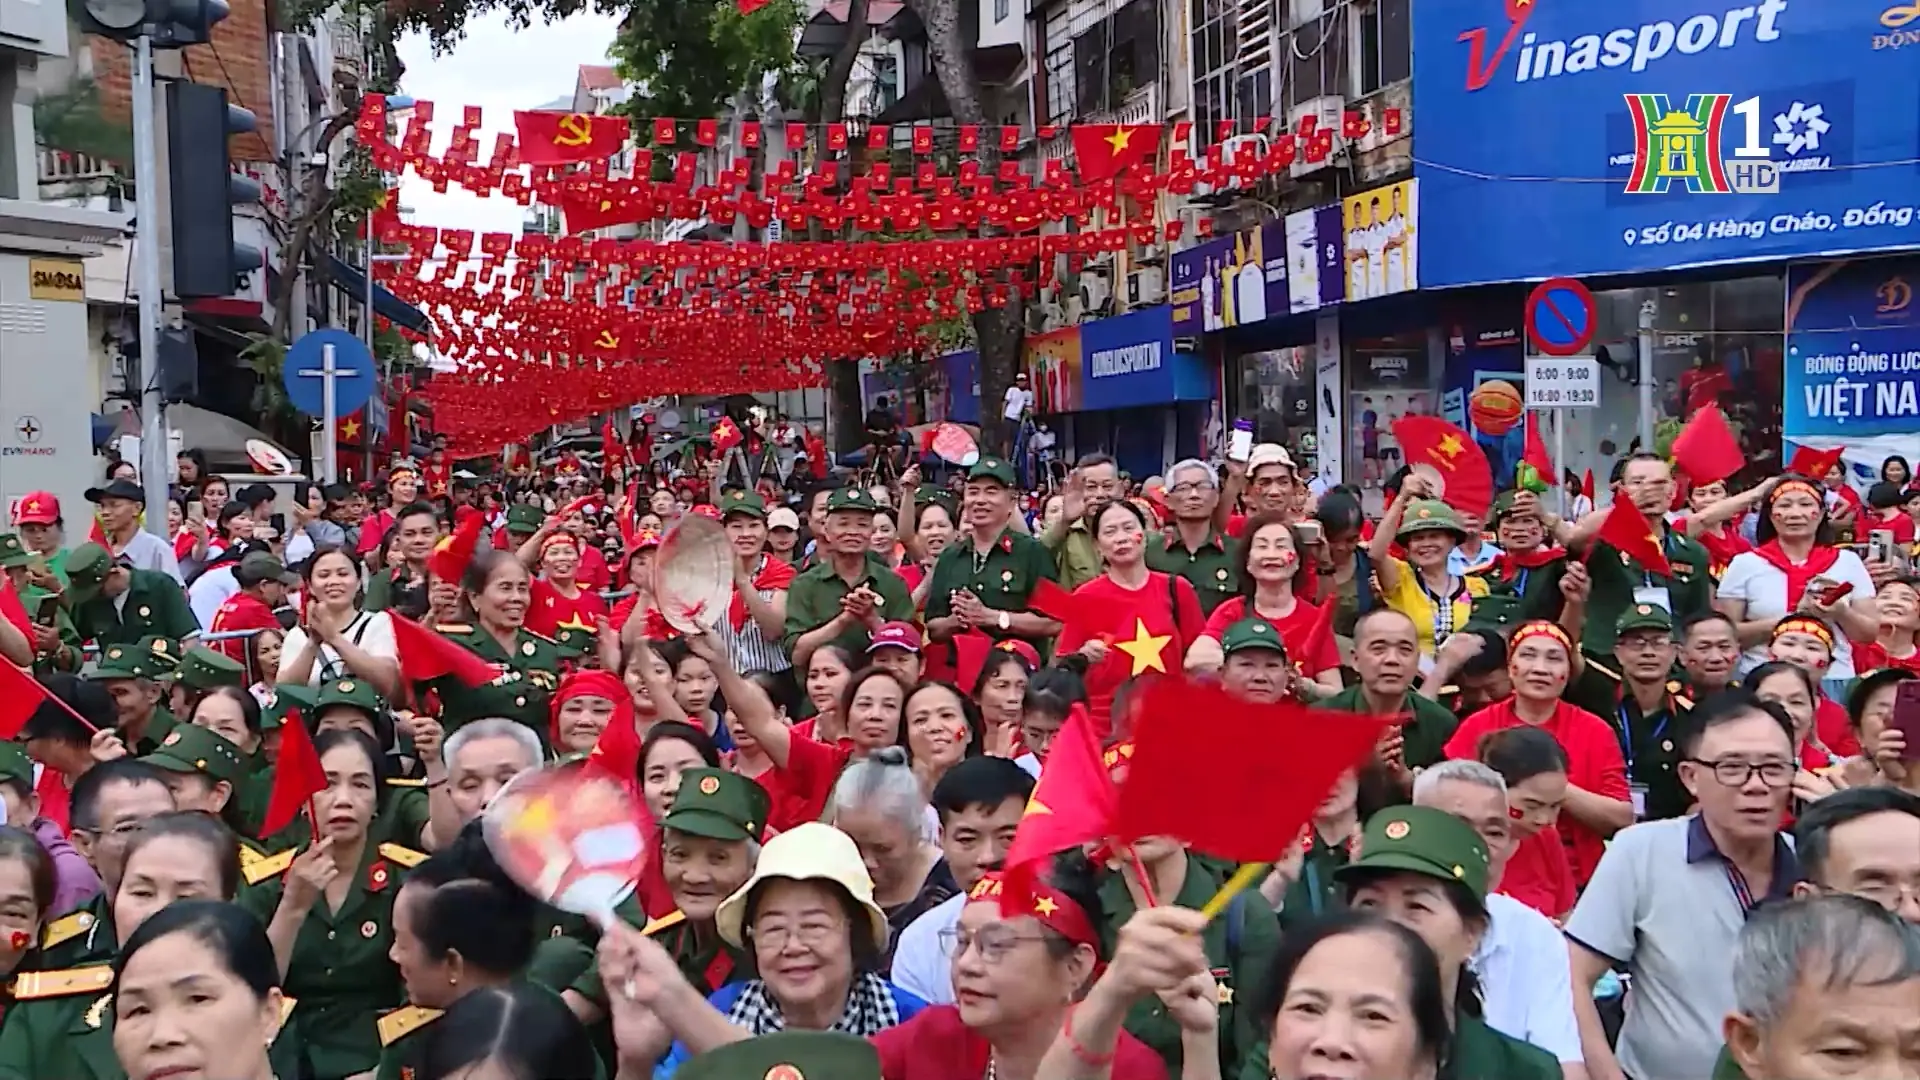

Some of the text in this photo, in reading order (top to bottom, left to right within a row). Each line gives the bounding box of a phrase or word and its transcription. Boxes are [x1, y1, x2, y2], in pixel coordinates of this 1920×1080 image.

[1457, 0, 1788, 91] Vinasport
[1639, 221, 1671, 245] Số
[1673, 225, 1704, 241] 04
[1706, 218, 1766, 239] Hàng
[1770, 211, 1838, 233] Cháo,
[1843, 201, 1914, 226] Đống
[1535, 367, 1559, 380] 6:00
[1567, 367, 1589, 380] 9:00
[1805, 351, 1920, 376] BÓNG ĐỘNG LỰC
[1804, 377, 1870, 425] VIỆT
